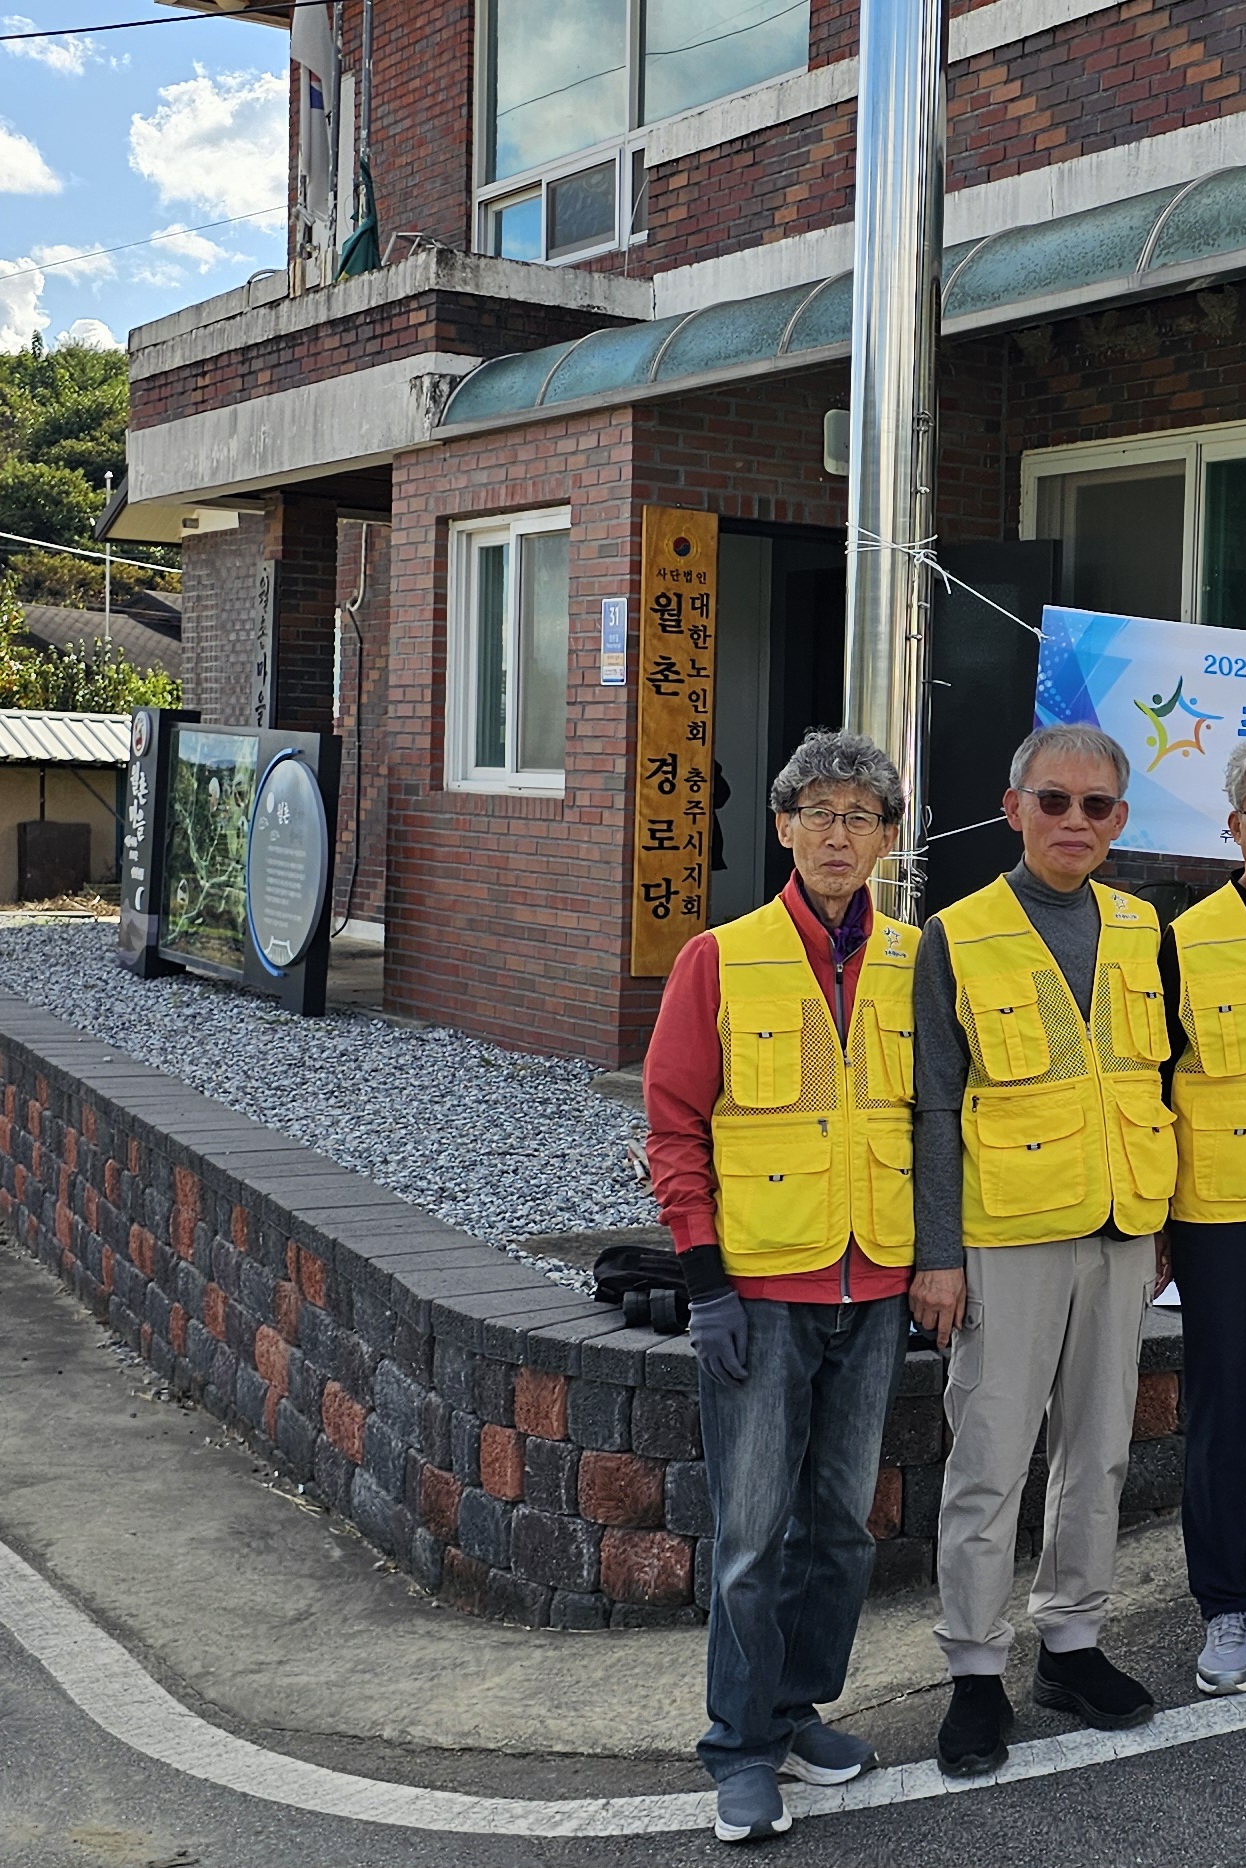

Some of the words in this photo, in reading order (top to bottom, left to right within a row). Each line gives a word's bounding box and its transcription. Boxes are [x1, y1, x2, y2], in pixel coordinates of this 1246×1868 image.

[609, 607, 619, 627] 31
[656, 567, 707, 584] 사단법인
[646, 592, 685, 697] 월촌
[686, 592, 712, 747] 대한노인회
[641, 753, 681, 920] 경로당
[681, 767, 708, 920] 충주시지회
